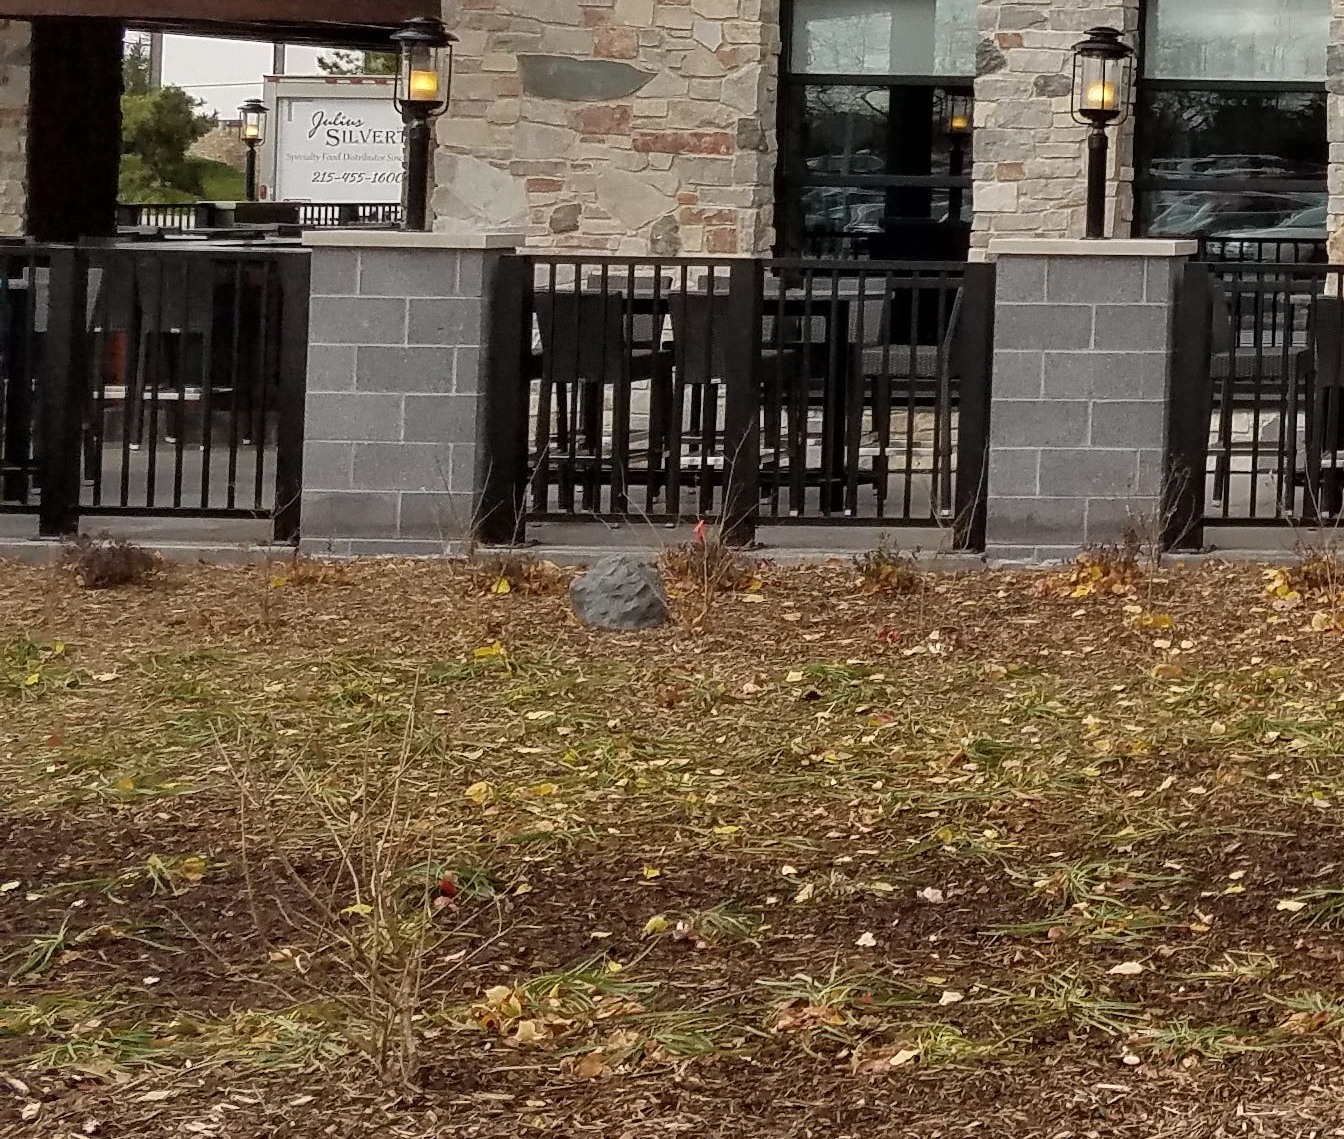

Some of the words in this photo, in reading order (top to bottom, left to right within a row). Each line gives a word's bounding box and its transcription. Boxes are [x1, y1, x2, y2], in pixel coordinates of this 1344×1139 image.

[308, 111, 365, 139] Julius
[322, 152, 341, 161] Food
[343, 152, 386, 161] Distributor
[387, 153, 403, 161] Sinc
